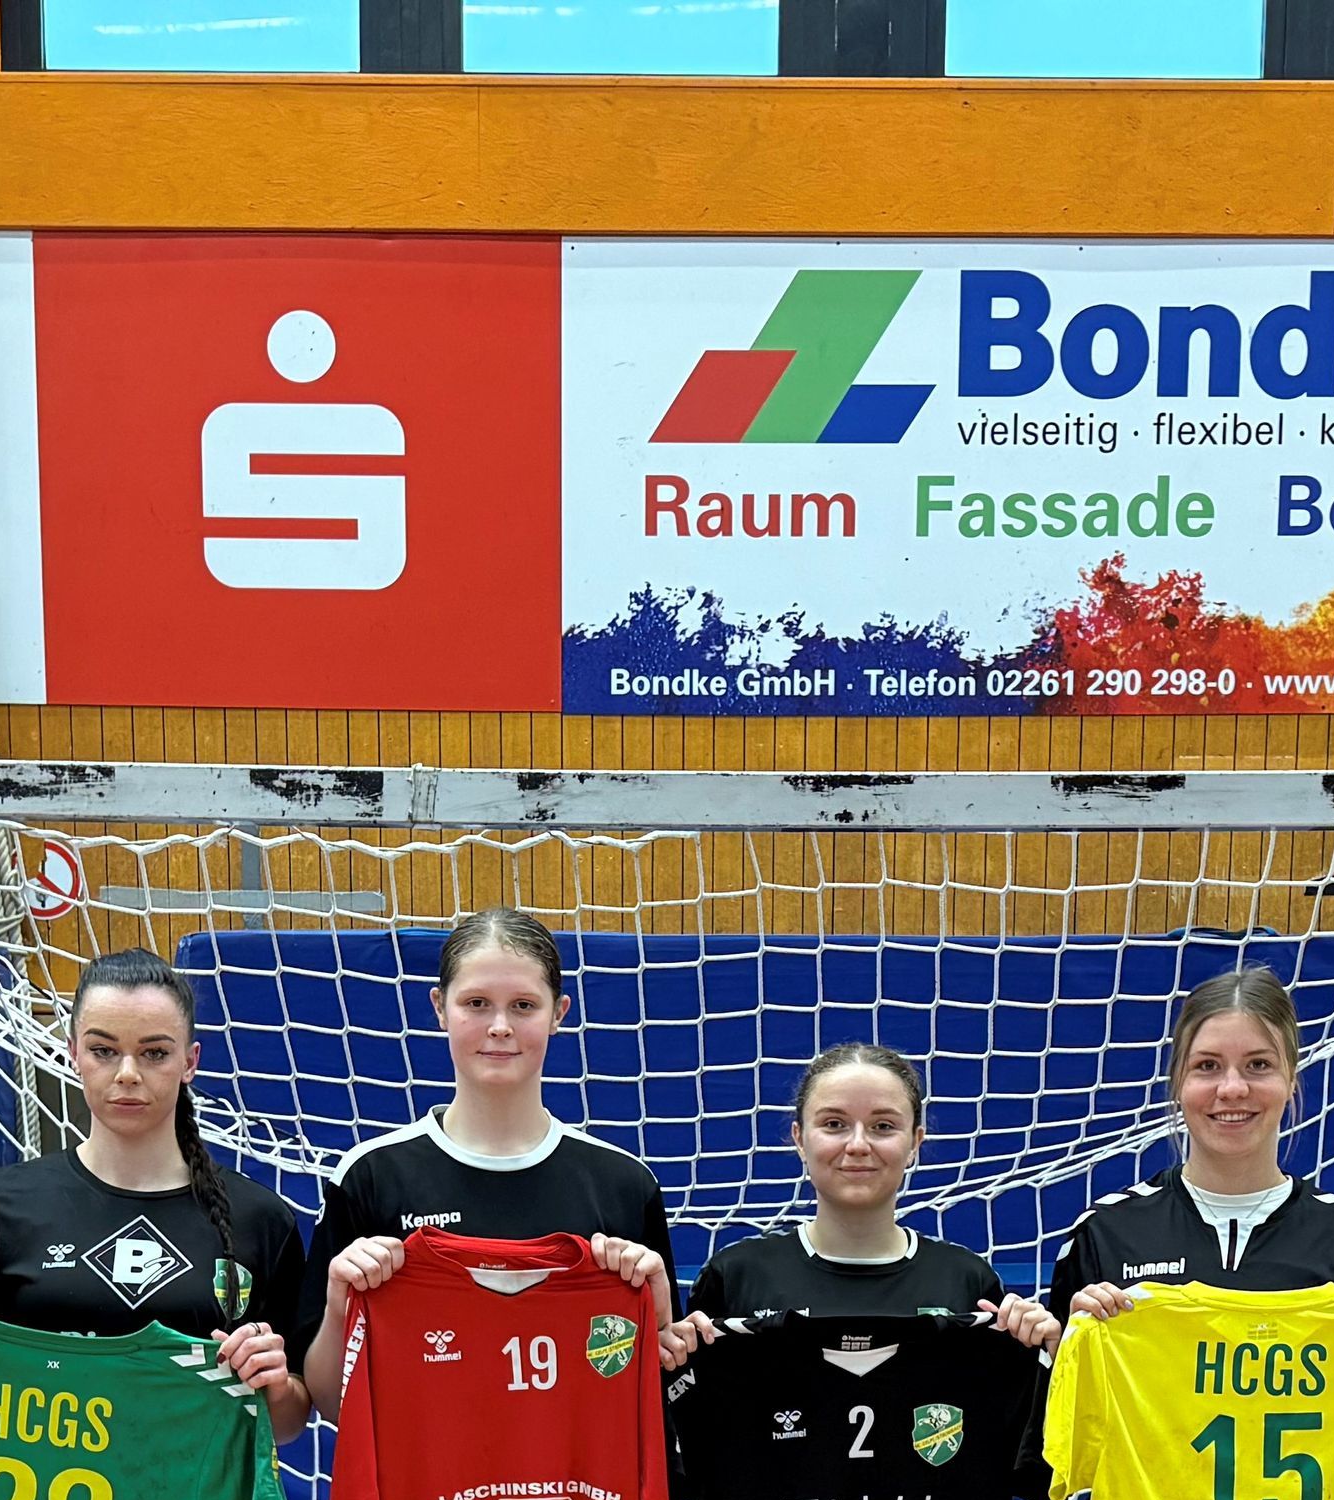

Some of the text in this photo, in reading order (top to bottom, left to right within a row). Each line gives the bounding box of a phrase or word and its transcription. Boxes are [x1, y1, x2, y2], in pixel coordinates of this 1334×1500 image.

[957, 413, 1119, 453] vielseitig
[1153, 413, 1285, 447] flexibel
[643, 474, 857, 538] Raum
[915, 474, 1216, 538] Fassade
[610, 668, 727, 697] Bondke
[736, 668, 836, 697] GmbH
[863, 668, 976, 697] Telefon
[986, 669, 1075, 697] 02261
[1086, 668, 1141, 696] 290
[1150, 668, 1236, 696] 298-0
[400, 1211, 462, 1231] Kempa
[1122, 1257, 1186, 1280] hummel
[423, 1350, 462, 1363] hummel
[501, 1335, 558, 1392] 19
[1194, 1340, 1328, 1397] HCGS
[772, 1428, 807, 1440] hummel
[848, 1405, 875, 1459] 2
